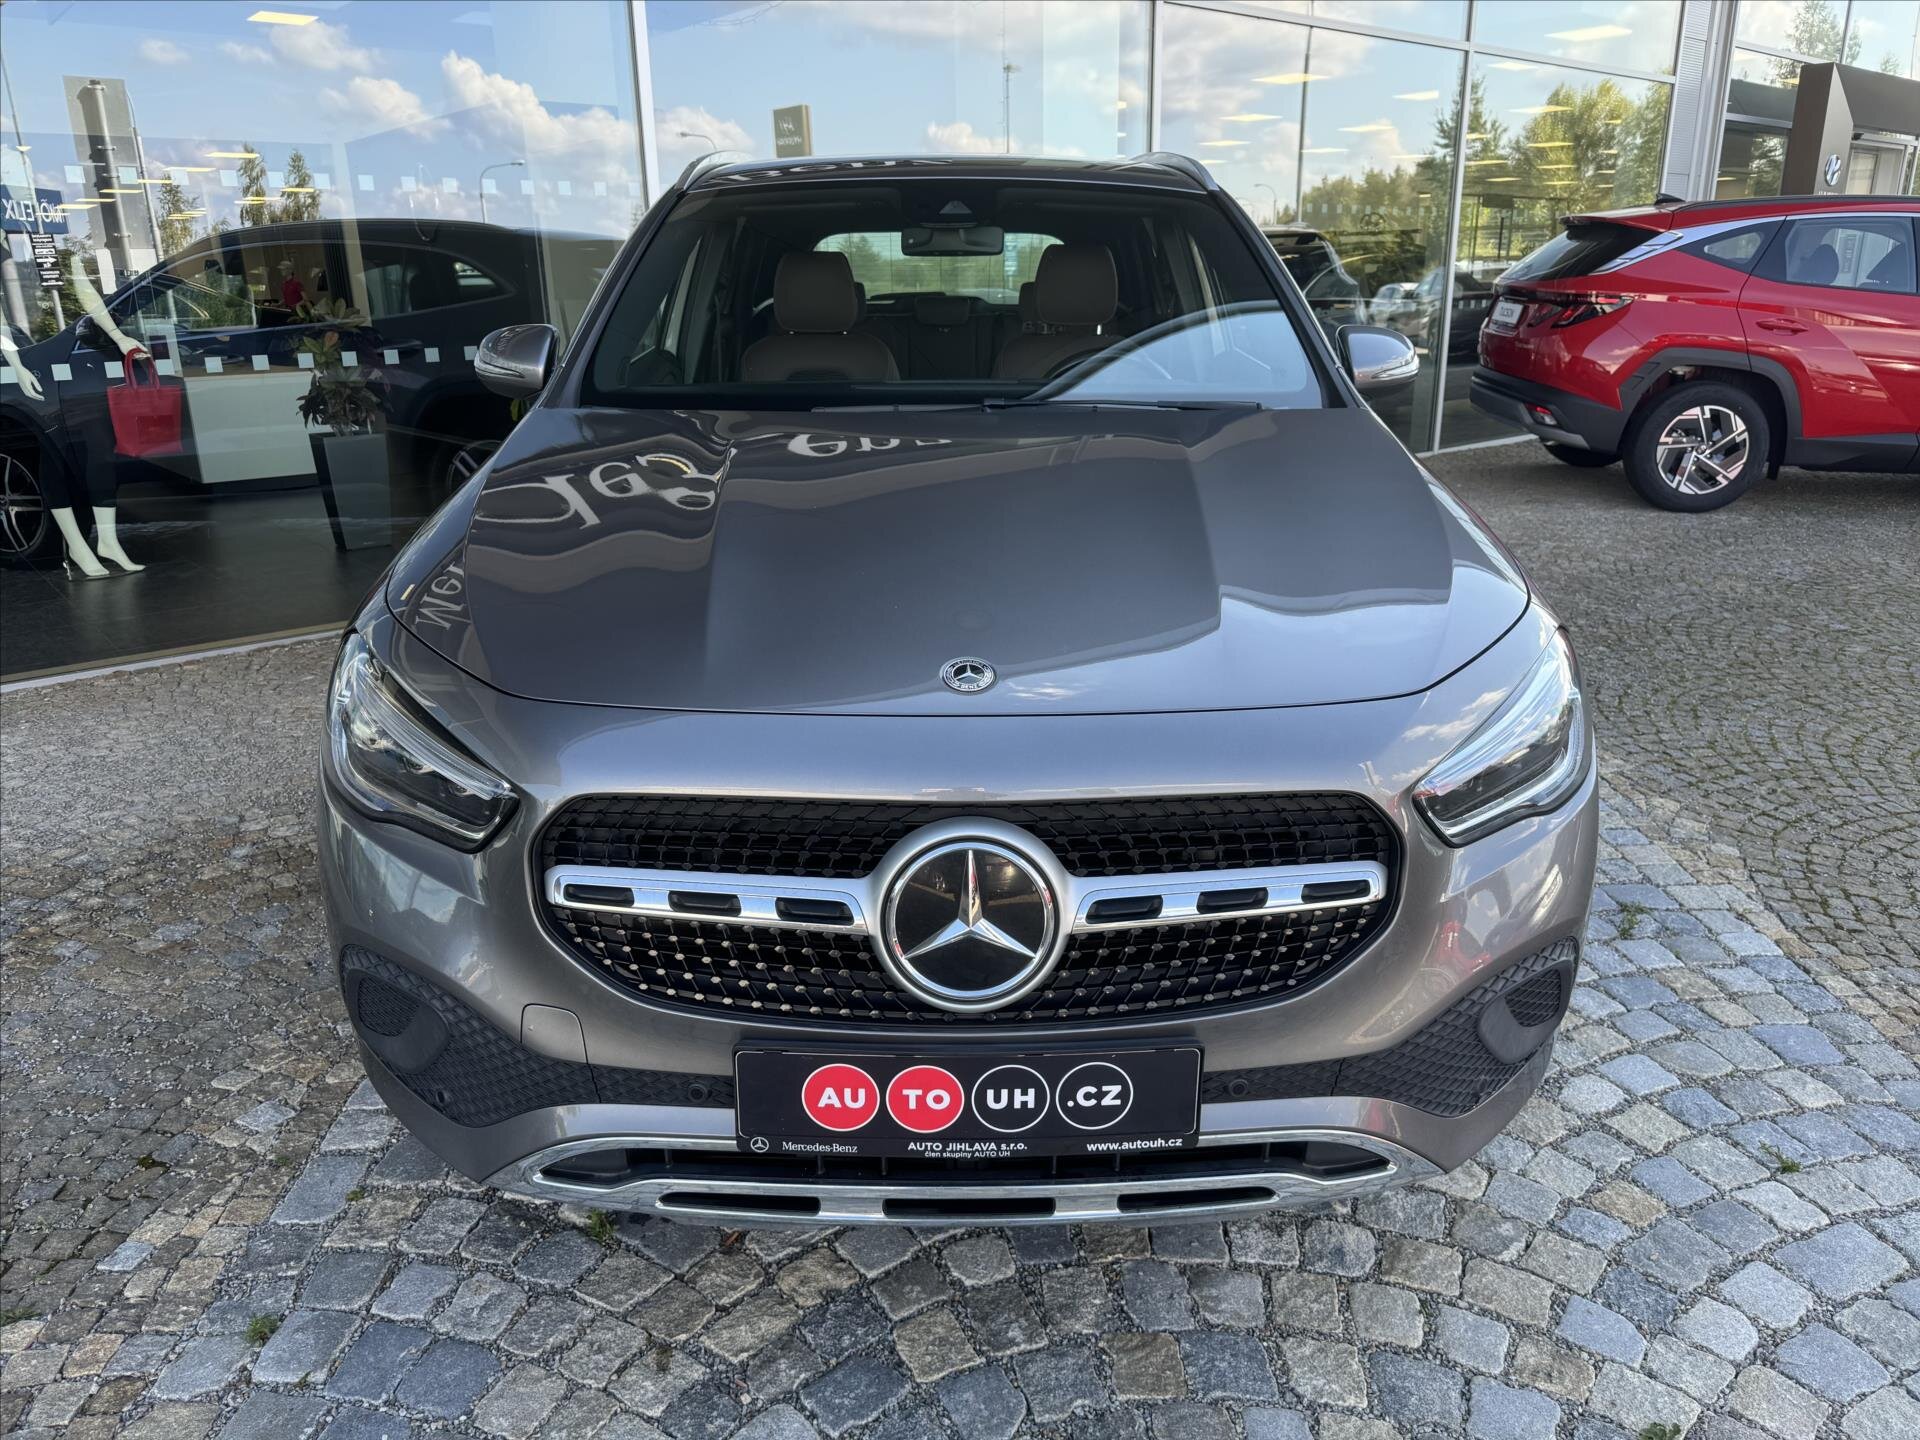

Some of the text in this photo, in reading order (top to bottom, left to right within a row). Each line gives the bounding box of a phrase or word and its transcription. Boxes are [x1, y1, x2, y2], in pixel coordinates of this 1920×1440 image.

[818, 1085, 1122, 1110] AU TO UH .CZ
[782, 1141, 858, 1153] Mercedes-Benz
[907, 1142, 1028, 1151] AUTO JIHLAVA s.r.o.
[1086, 1137, 1183, 1152] www.autouh.cz
[924, 1150, 941, 1158] člen
[942, 1150, 972, 1159] skupiny
[973, 1150, 997, 1158] AUTO
